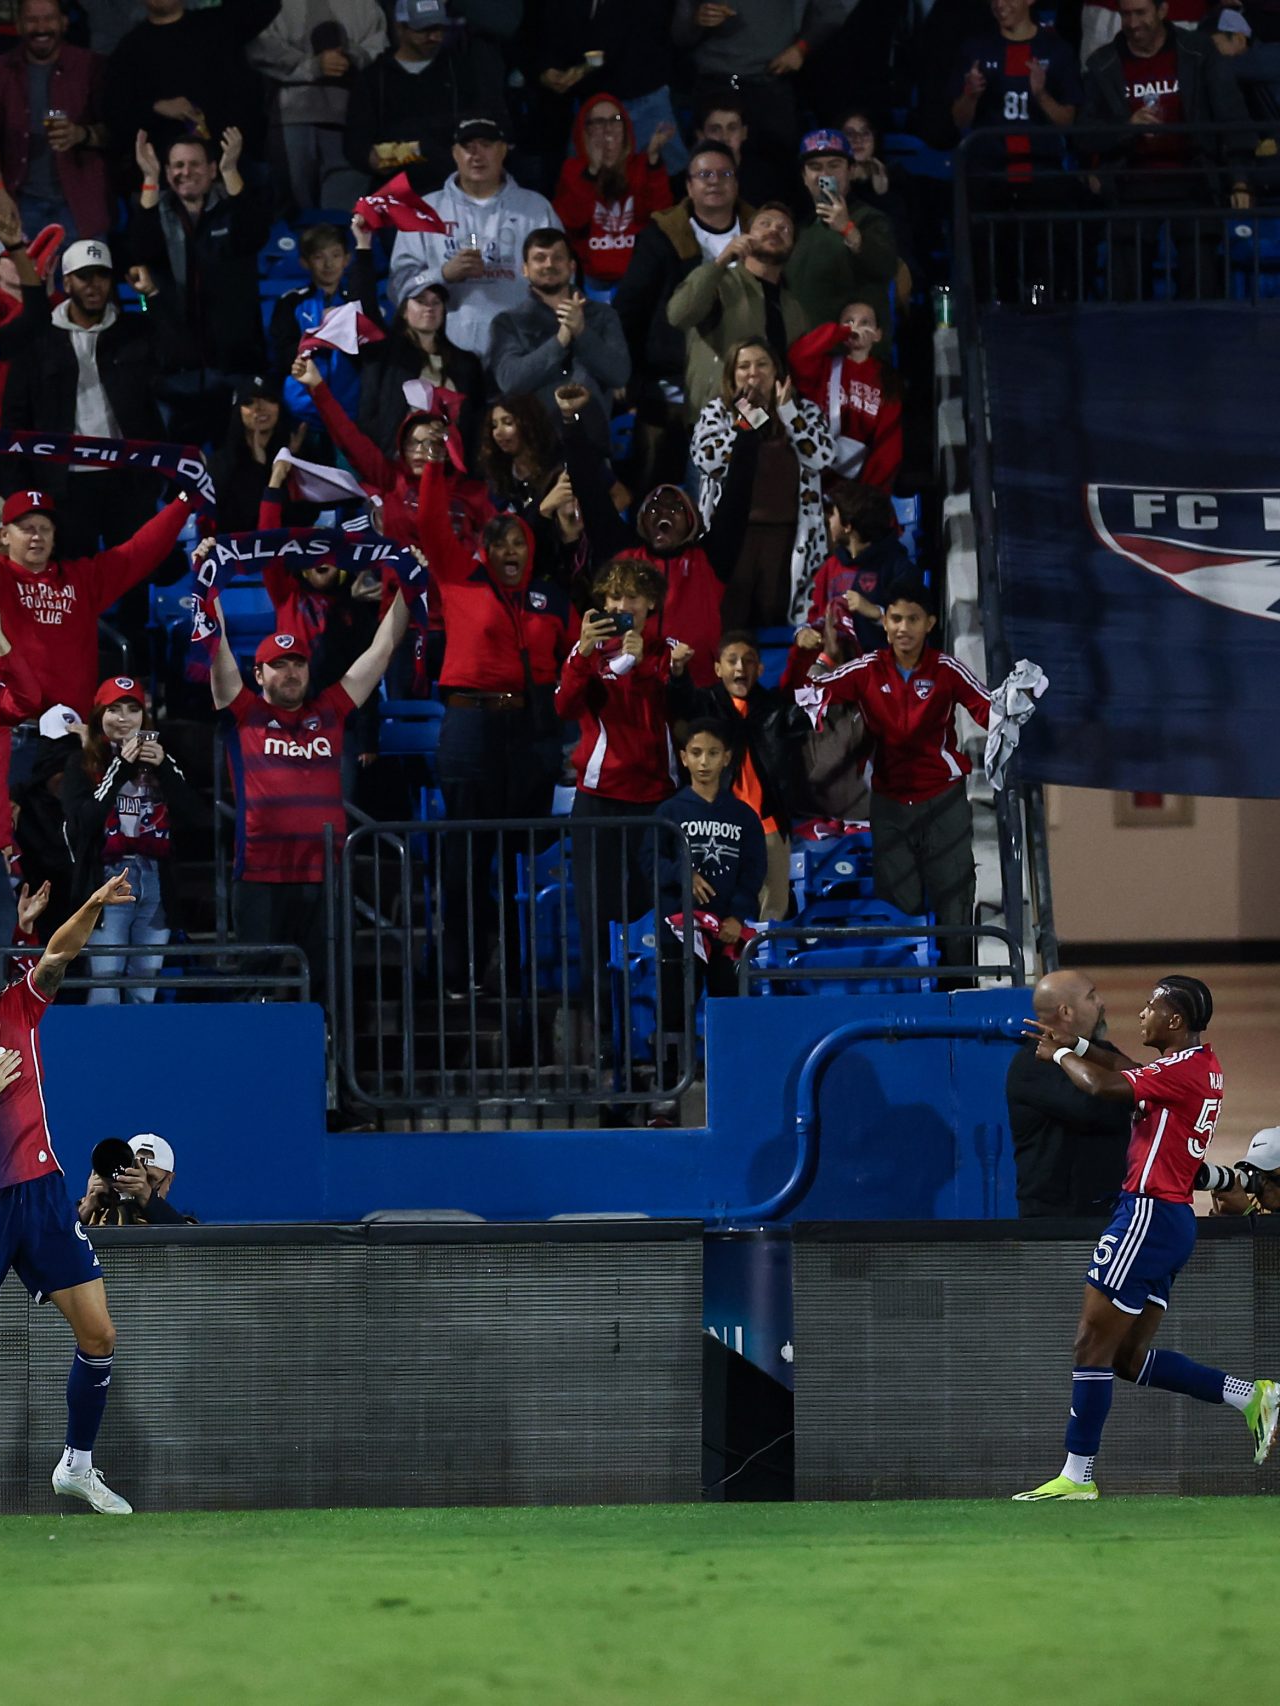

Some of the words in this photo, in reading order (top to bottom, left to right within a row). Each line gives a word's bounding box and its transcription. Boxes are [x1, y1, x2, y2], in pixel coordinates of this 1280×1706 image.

[1003, 91, 1030, 120] 81
[588, 233, 636, 250] adida
[27, 491, 42, 506] T
[1133, 493, 1219, 530] FC
[197, 539, 331, 587] DALLAS
[1187, 1098, 1222, 1160] 5
